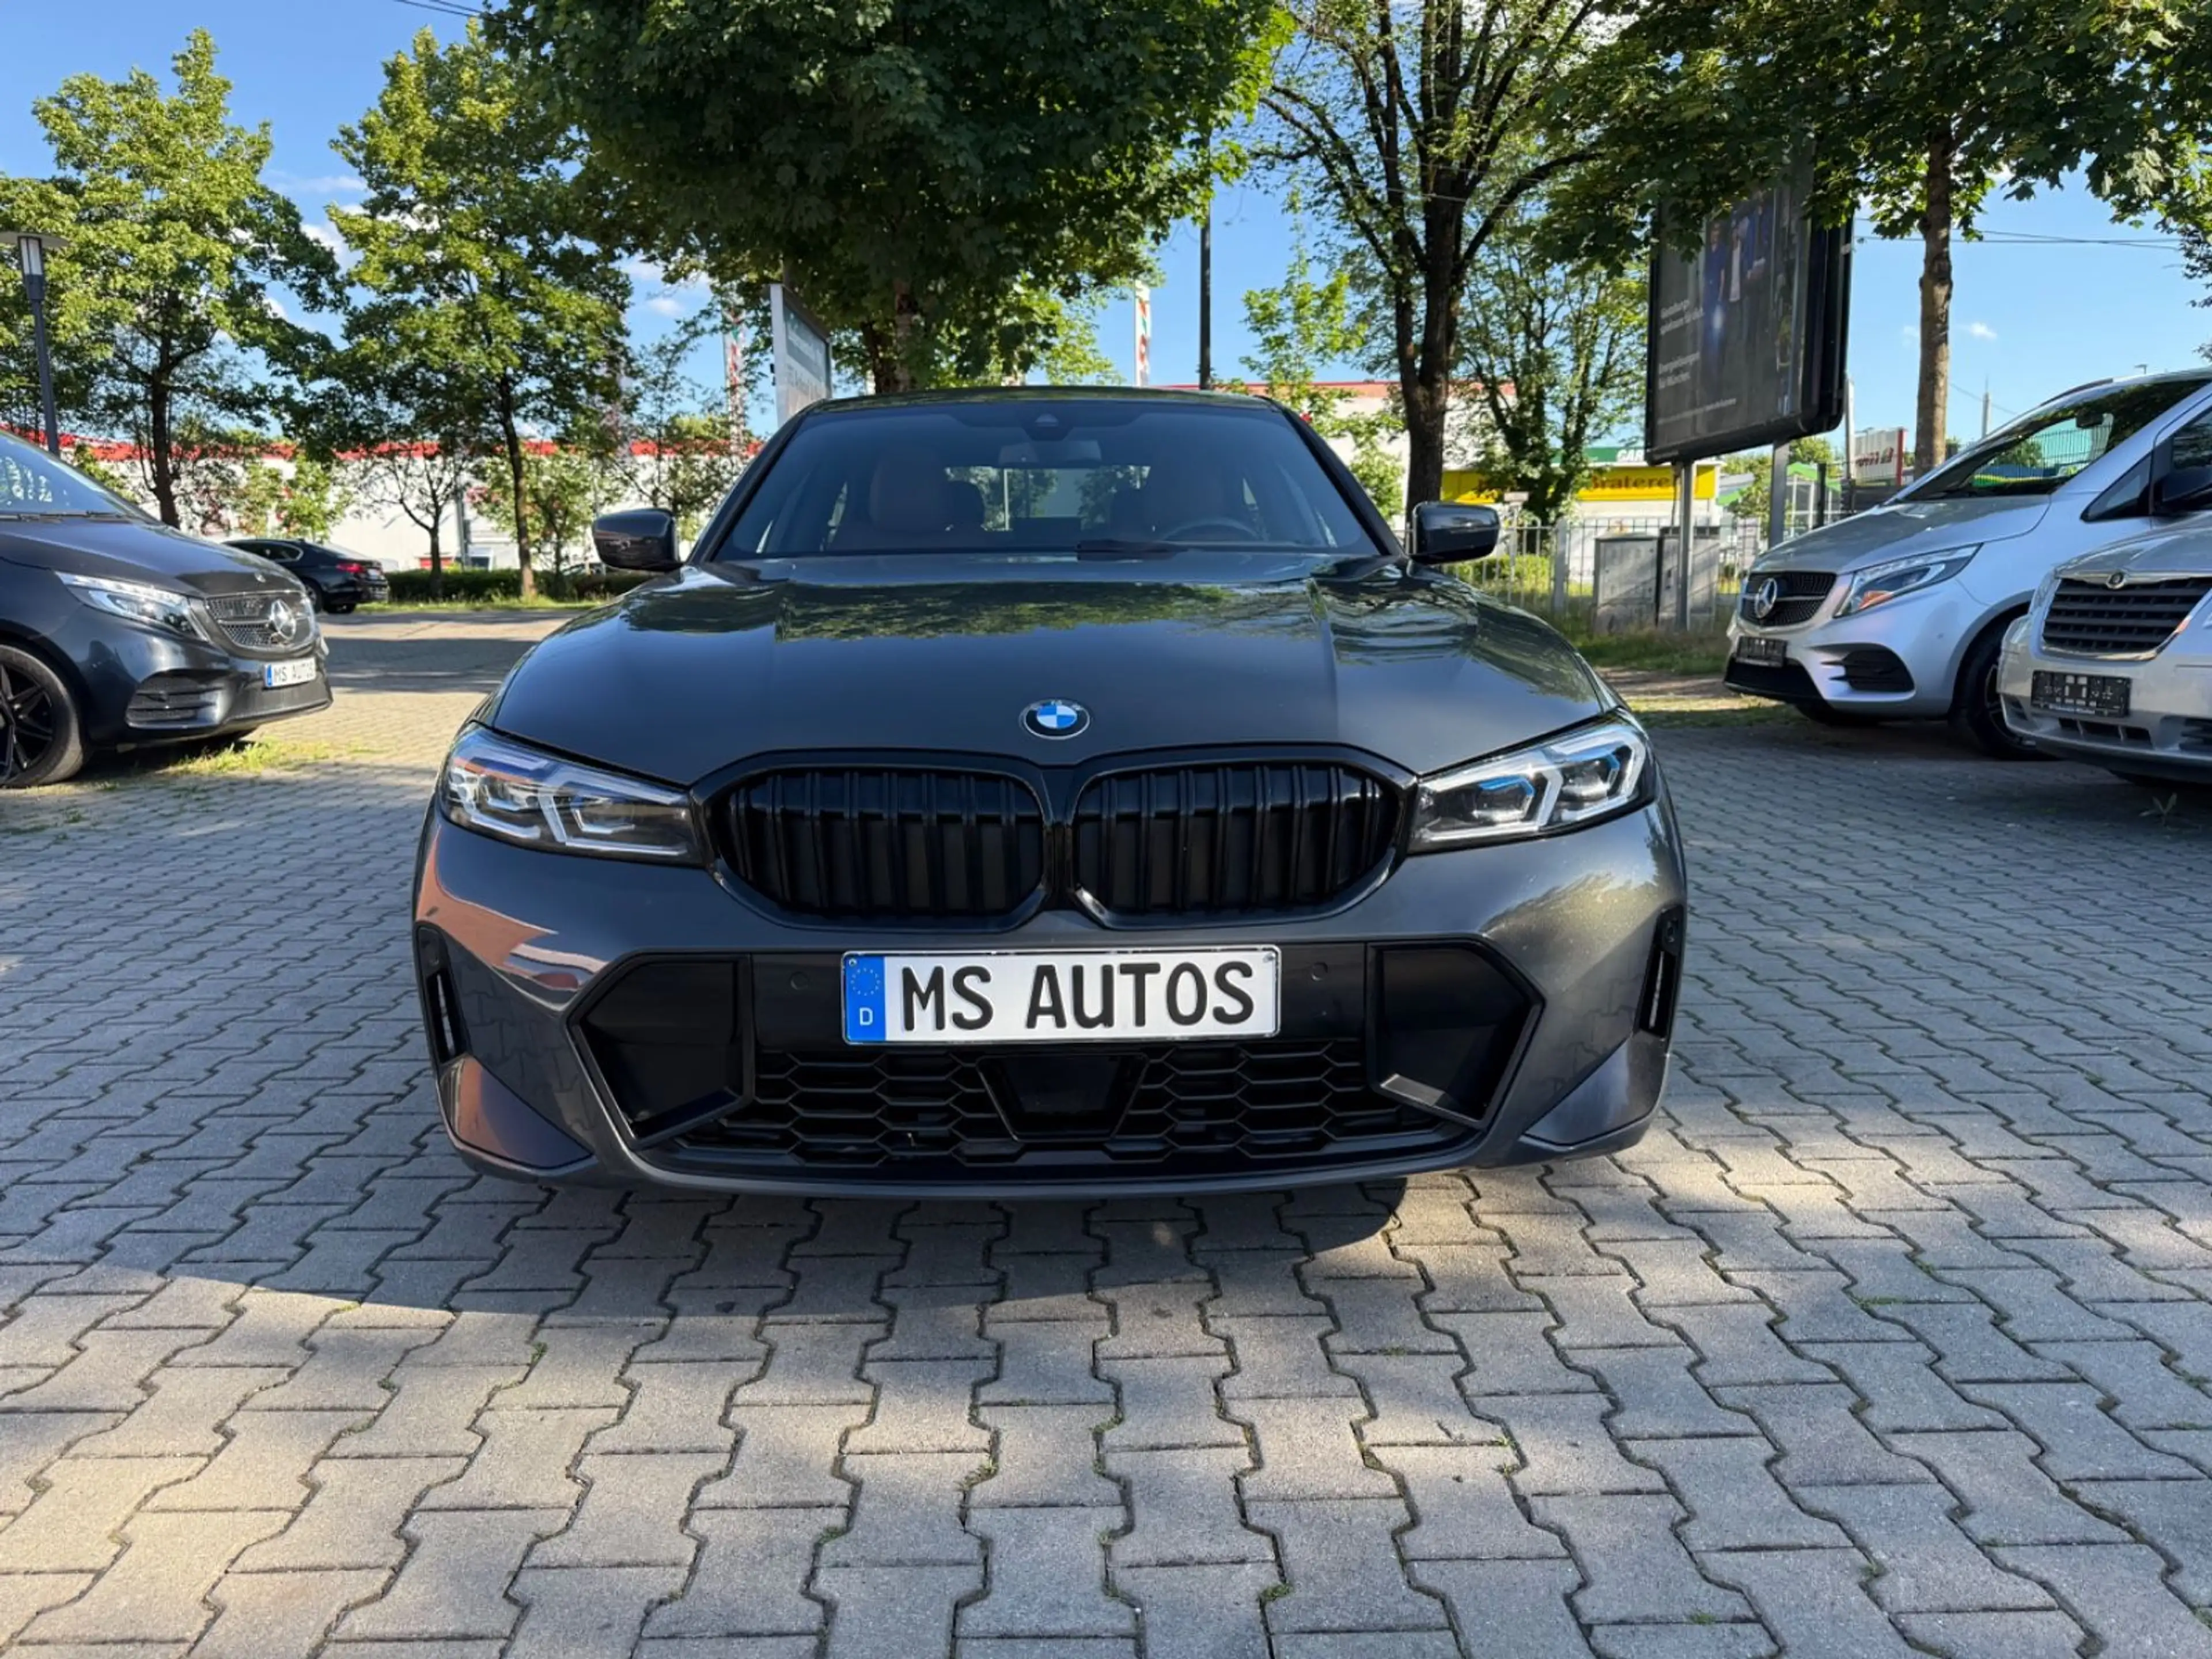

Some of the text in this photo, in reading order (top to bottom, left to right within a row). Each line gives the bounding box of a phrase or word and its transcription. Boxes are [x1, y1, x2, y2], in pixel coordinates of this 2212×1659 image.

[859, 1007, 873, 1026] D
[901, 961, 1254, 1032] MS AUTOS
